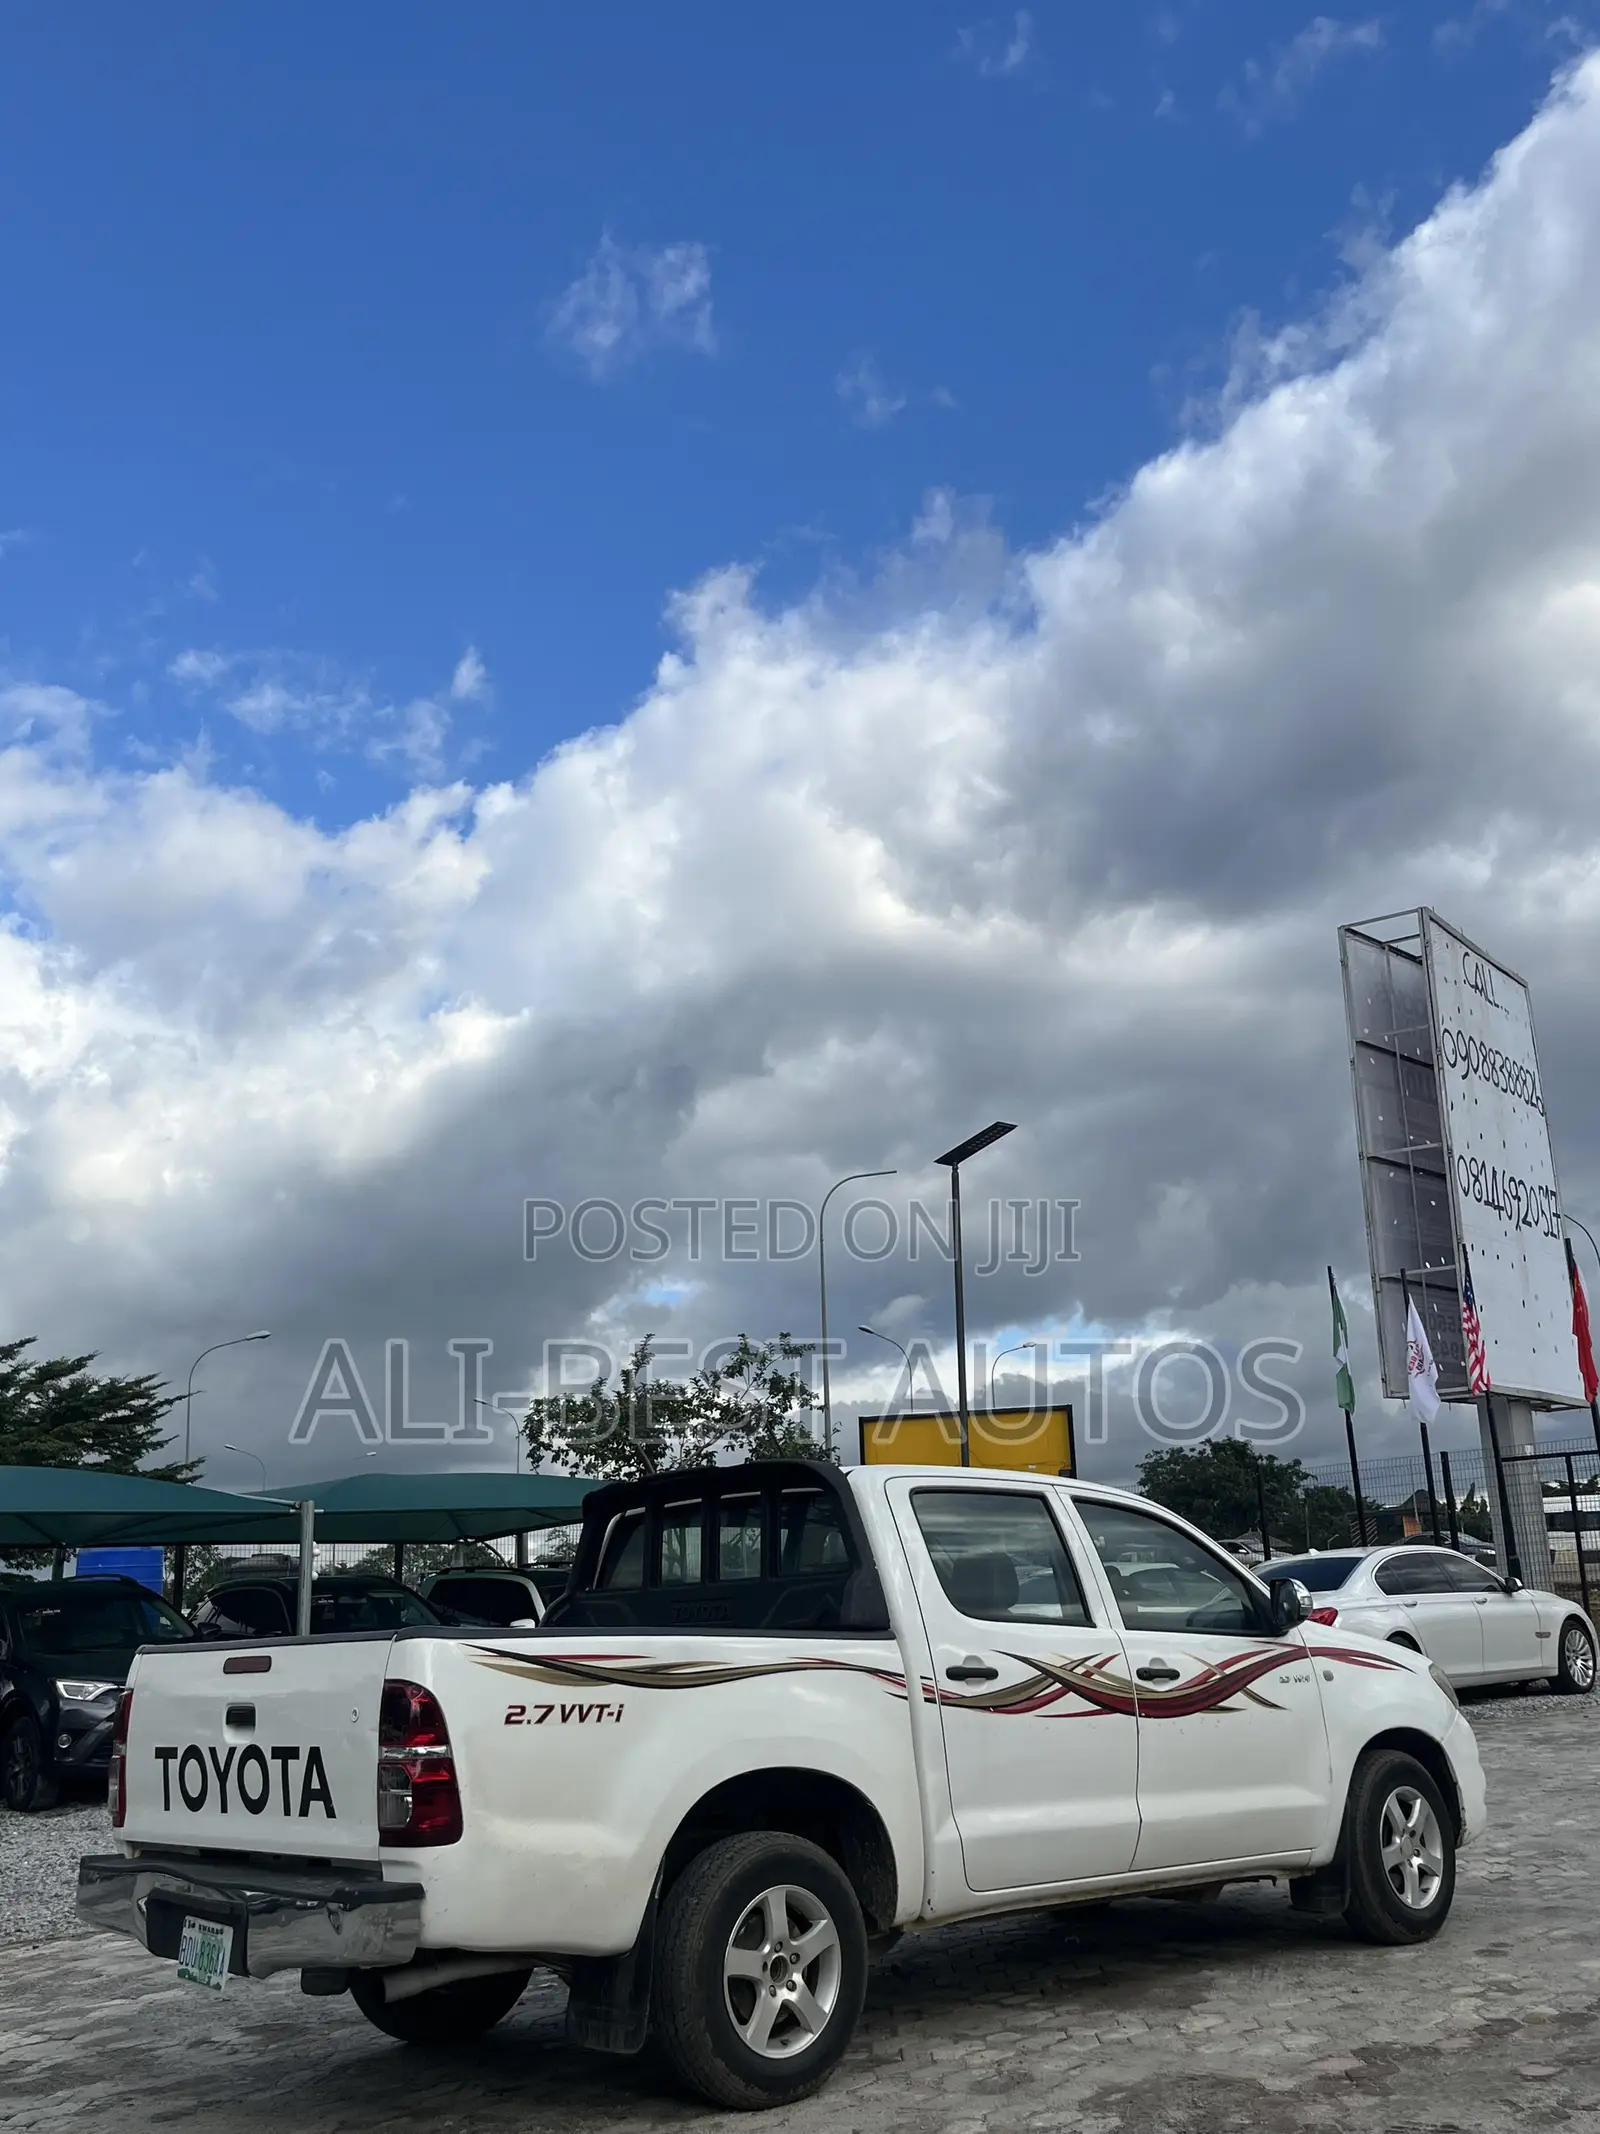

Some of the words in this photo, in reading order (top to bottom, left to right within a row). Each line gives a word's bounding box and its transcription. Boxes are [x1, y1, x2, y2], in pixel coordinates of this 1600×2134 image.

[1457, 1154, 1560, 1240] 08146920517
[504, 1704, 555, 1725] 2.7
[560, 1703, 624, 1723] VVT-i
[155, 1744, 337, 1819] TOYOTA
